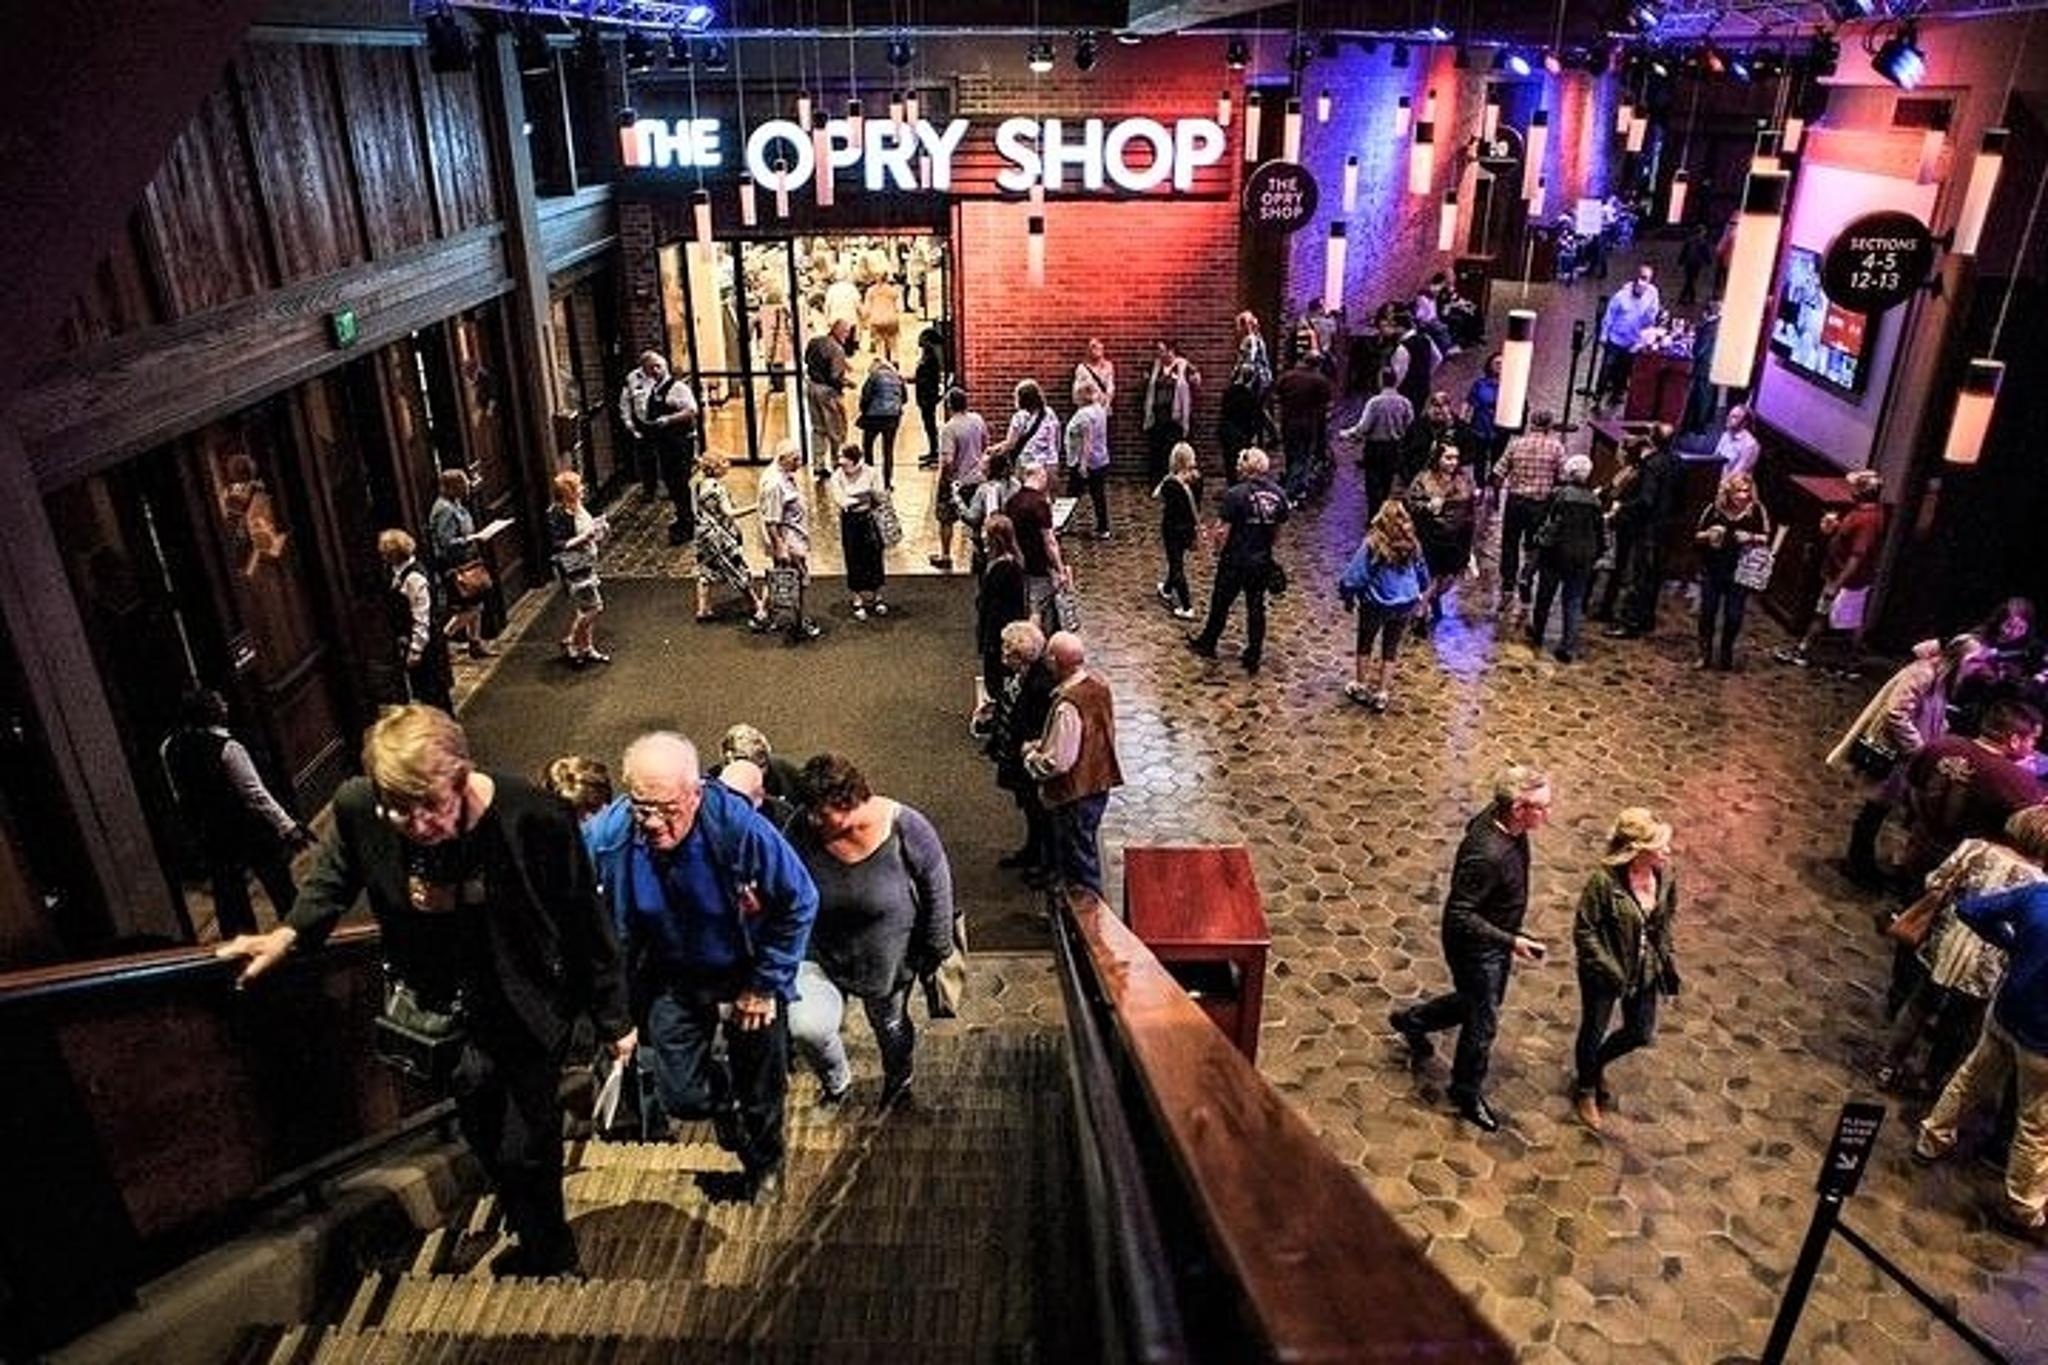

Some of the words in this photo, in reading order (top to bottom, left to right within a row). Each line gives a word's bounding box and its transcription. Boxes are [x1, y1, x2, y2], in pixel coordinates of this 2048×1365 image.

[634, 118, 722, 168] THE
[747, 119, 968, 192] OPRY
[996, 117, 1226, 192] SHOP
[1268, 177, 1297, 191] THE
[1261, 191, 1303, 206] OPRY
[1260, 206, 1303, 220] SHOP
[1850, 238, 1918, 251] SECTIONS
[1862, 252, 1897, 270] 4-5
[1850, 272, 1900, 290] 12-13
